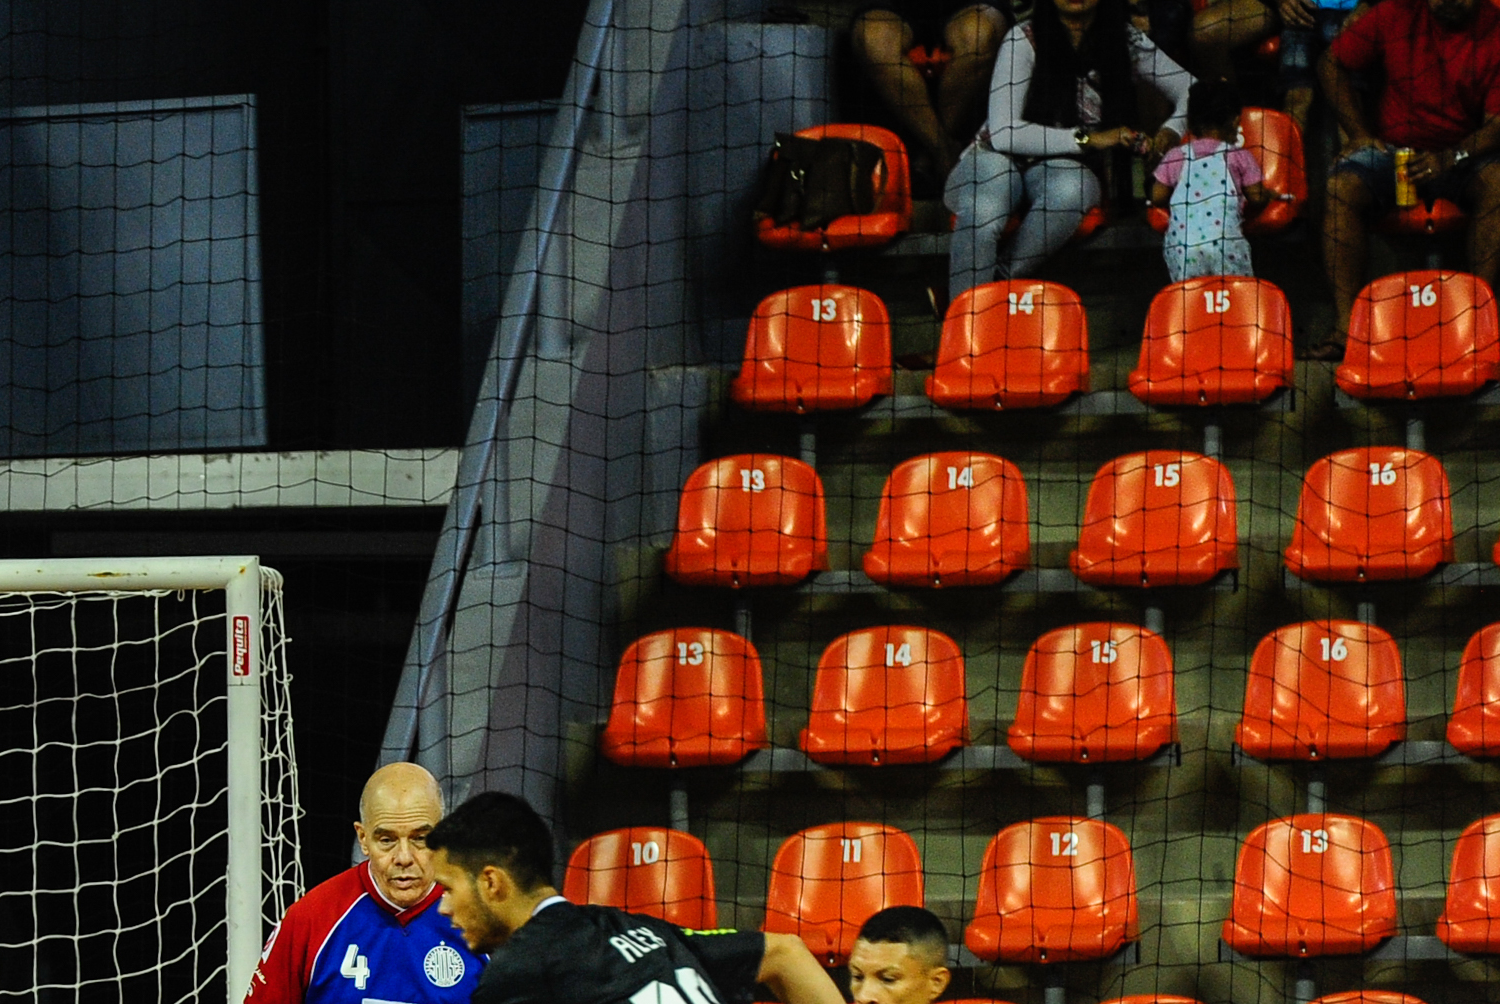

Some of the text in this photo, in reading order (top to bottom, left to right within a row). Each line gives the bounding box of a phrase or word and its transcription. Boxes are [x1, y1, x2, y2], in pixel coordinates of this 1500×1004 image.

[1009, 292, 1034, 314] 14
[1205, 291, 1229, 312] 15
[1411, 285, 1436, 306] 16
[812, 299, 836, 320] 13
[741, 470, 764, 492] 13
[948, 468, 973, 489] 14
[1155, 464, 1180, 486] 15
[1370, 463, 1396, 485] 16
[234, 618, 247, 676] Pequita
[678, 641, 704, 664] 13
[887, 644, 914, 666] 14
[1092, 641, 1117, 663] 15
[1321, 638, 1347, 660] 16
[841, 839, 861, 862] 11
[1051, 832, 1078, 855] 12
[1301, 830, 1328, 852] 13
[633, 842, 659, 864] 10
[609, 926, 667, 964] ALEX
[339, 943, 371, 990] 4
